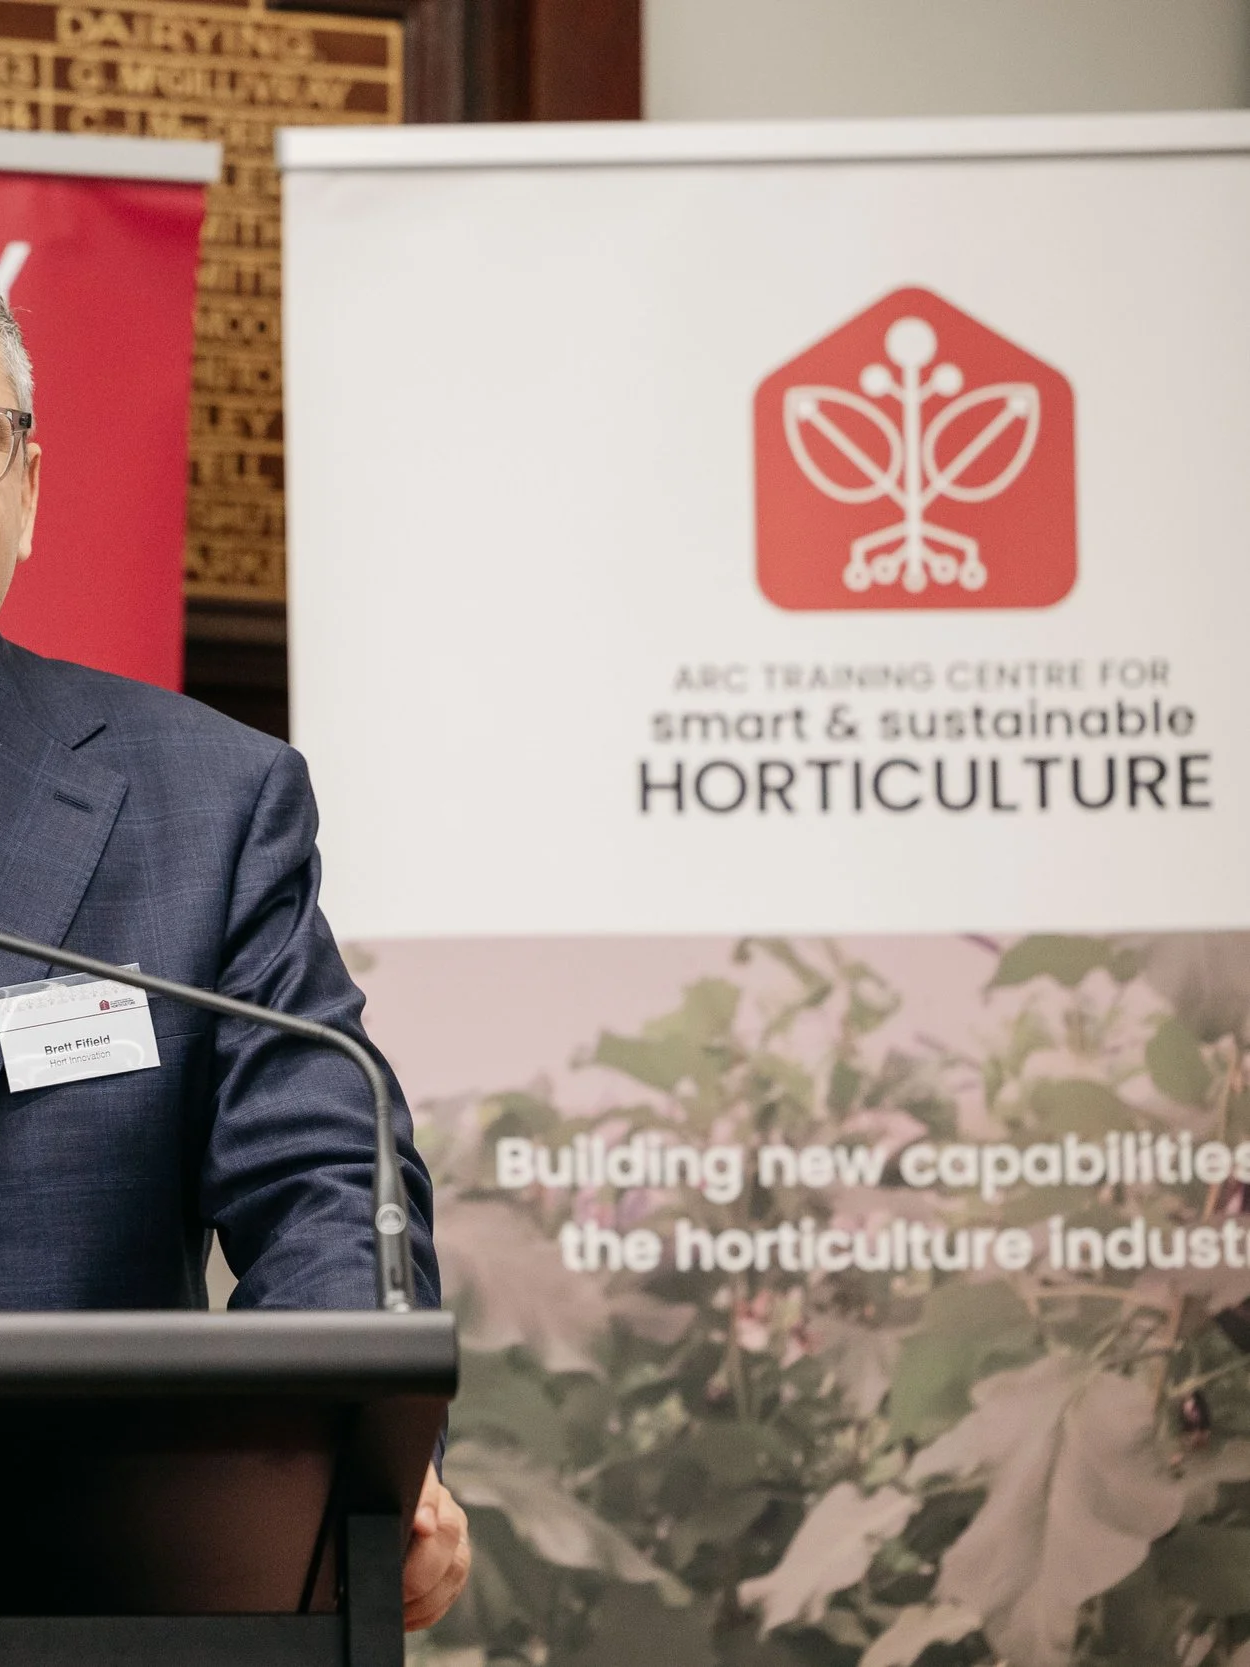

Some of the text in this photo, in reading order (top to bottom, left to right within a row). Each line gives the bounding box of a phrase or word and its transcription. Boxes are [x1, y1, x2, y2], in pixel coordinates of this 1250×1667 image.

[672, 658, 1170, 694] ARC TRAINING CENTRE FOR
[650, 698, 1196, 744] smart & sustainable
[638, 752, 1213, 816] HORTICULTURE
[45, 1035, 110, 1055] Brett Fifield
[50, 1051, 111, 1068] Hort Innovation
[496, 1135, 743, 1203] Building
[758, 1143, 888, 1187] new
[560, 1214, 1250, 1274] the horticulture indust
